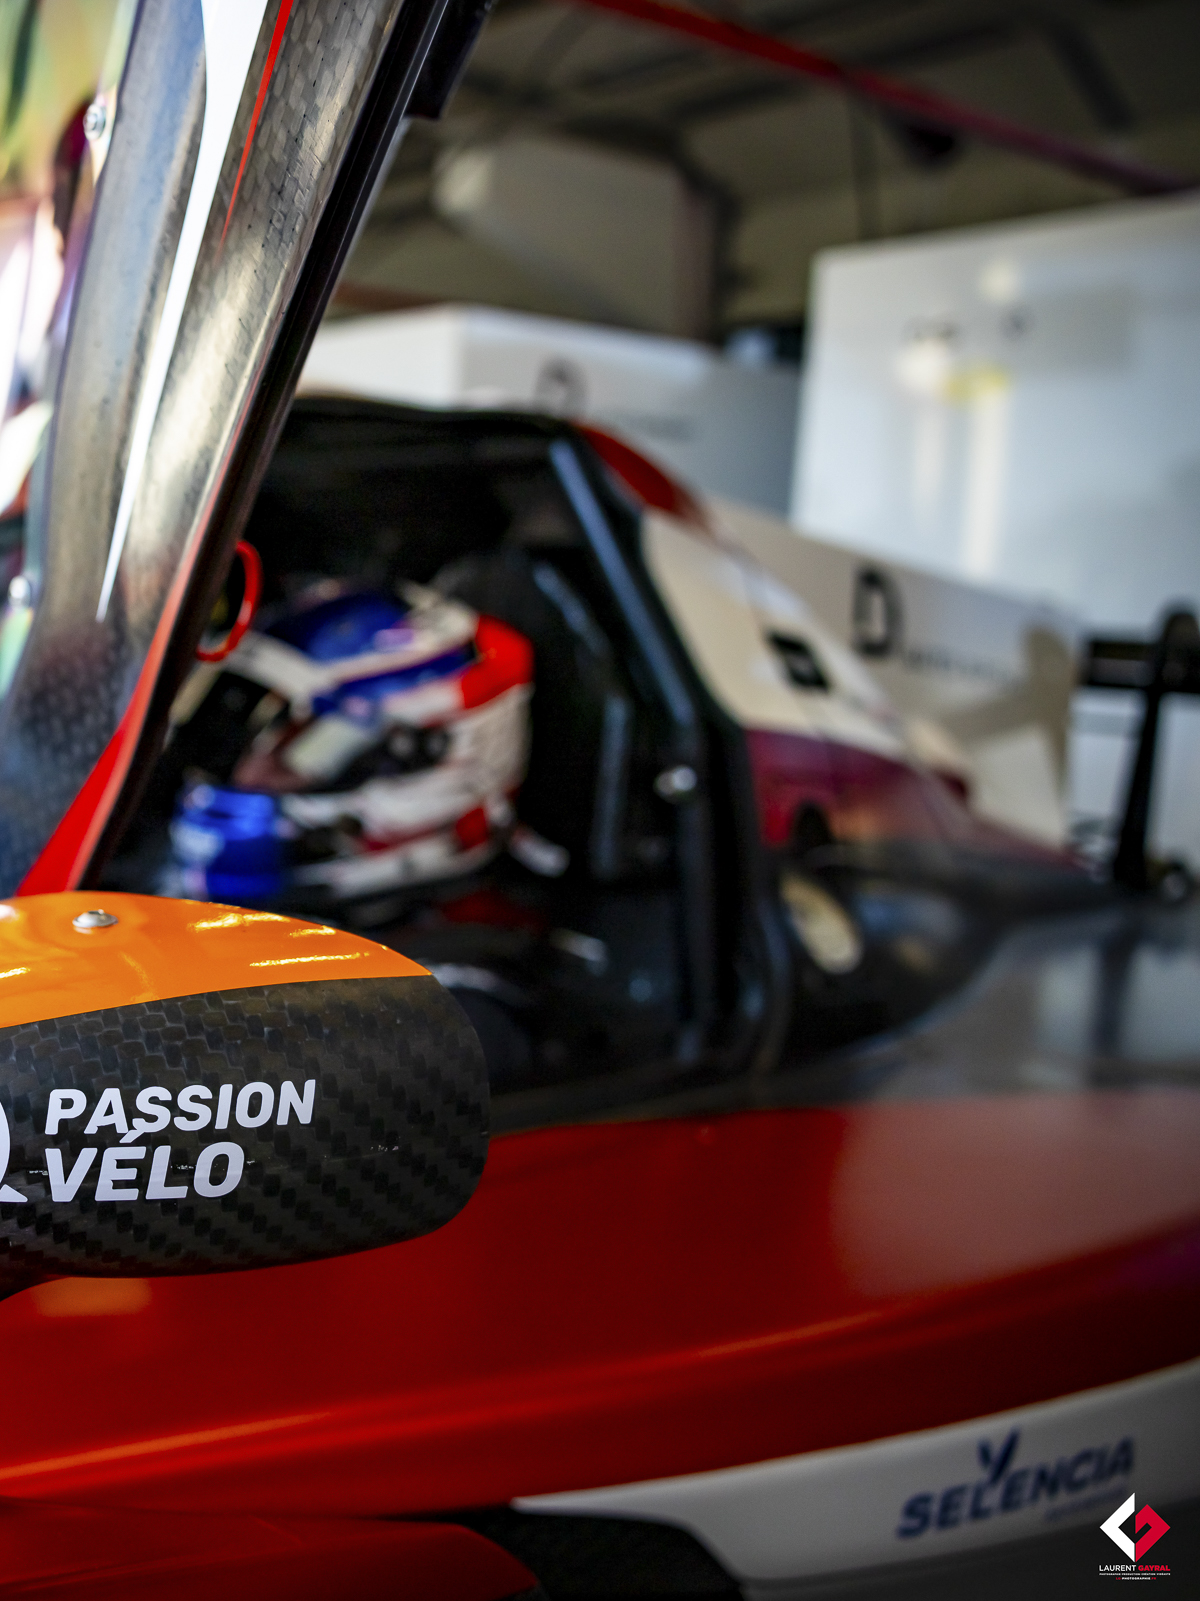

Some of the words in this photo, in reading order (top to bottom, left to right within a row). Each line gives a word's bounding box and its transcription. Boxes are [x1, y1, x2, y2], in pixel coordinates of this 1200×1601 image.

[44, 1079, 316, 1138] PASSION
[44, 1128, 245, 1203] VÉLO
[896, 1434, 1135, 1540] SELENCIA
